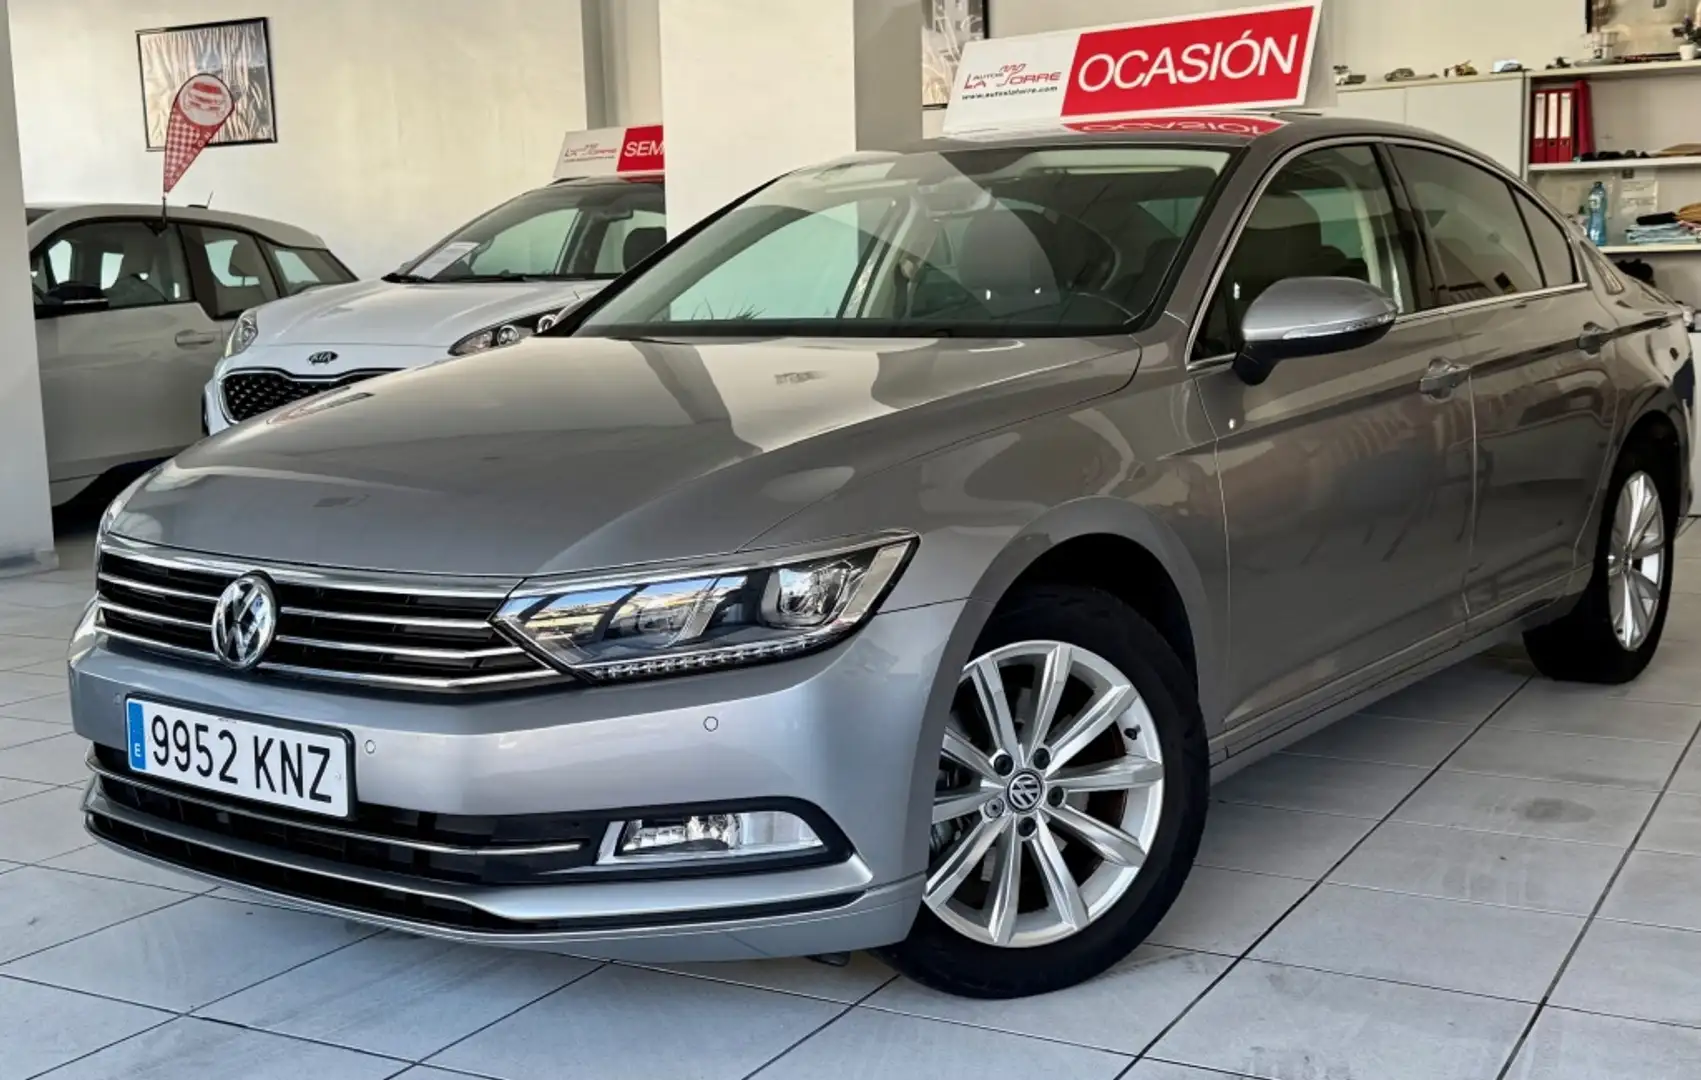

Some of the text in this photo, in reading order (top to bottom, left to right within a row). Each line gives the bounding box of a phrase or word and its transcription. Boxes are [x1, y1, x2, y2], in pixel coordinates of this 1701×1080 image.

[1078, 29, 1298, 92] OCASIÓN
[964, 73, 987, 89] LA
[309, 352, 334, 363] KIA
[134, 715, 332, 803] E 9952 KNZ
